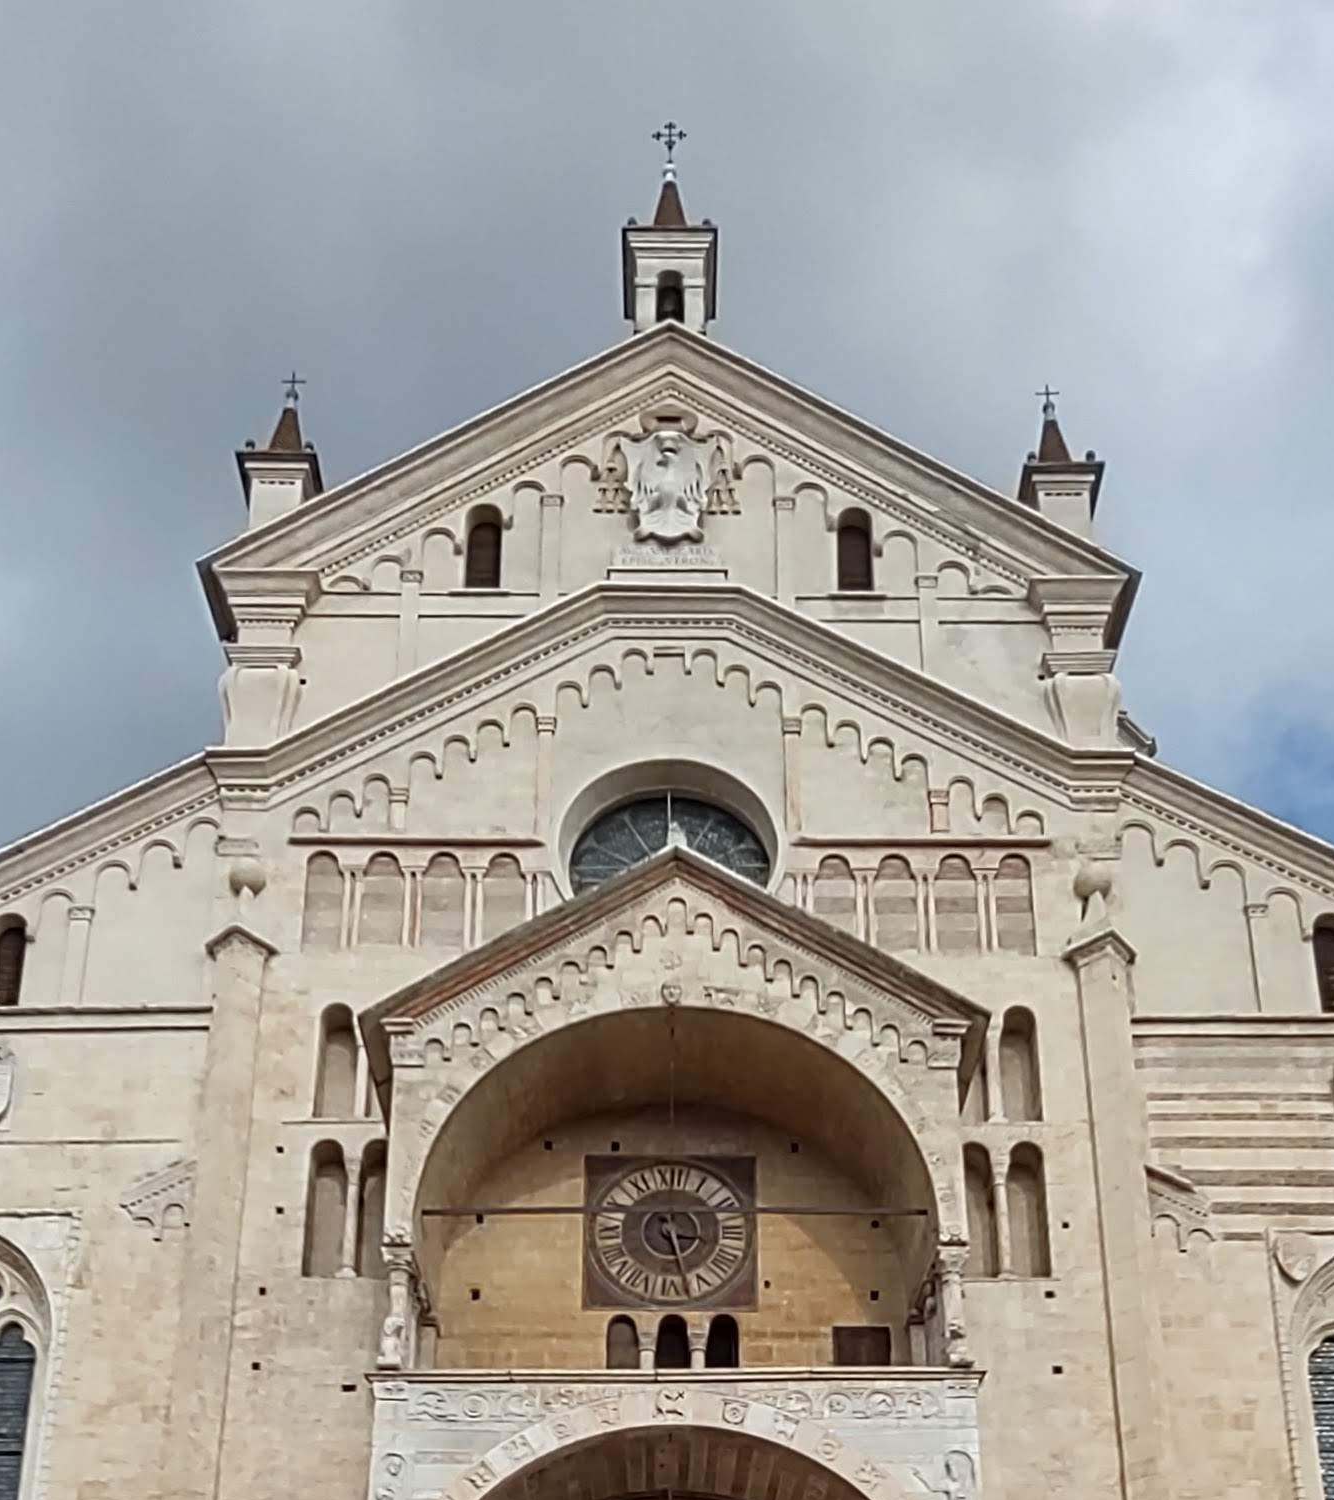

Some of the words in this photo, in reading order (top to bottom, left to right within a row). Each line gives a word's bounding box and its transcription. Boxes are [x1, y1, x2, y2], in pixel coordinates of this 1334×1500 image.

[628, 1173, 651, 1197] XI
[657, 1168, 683, 1190] XII
[695, 1176, 708, 1193] I
[722, 1225, 744, 1242] III
[710, 1248, 738, 1274] IIII
[625, 1267, 650, 1294] VII
[661, 1277, 680, 1297] VI
[695, 1273, 712, 1293] V
